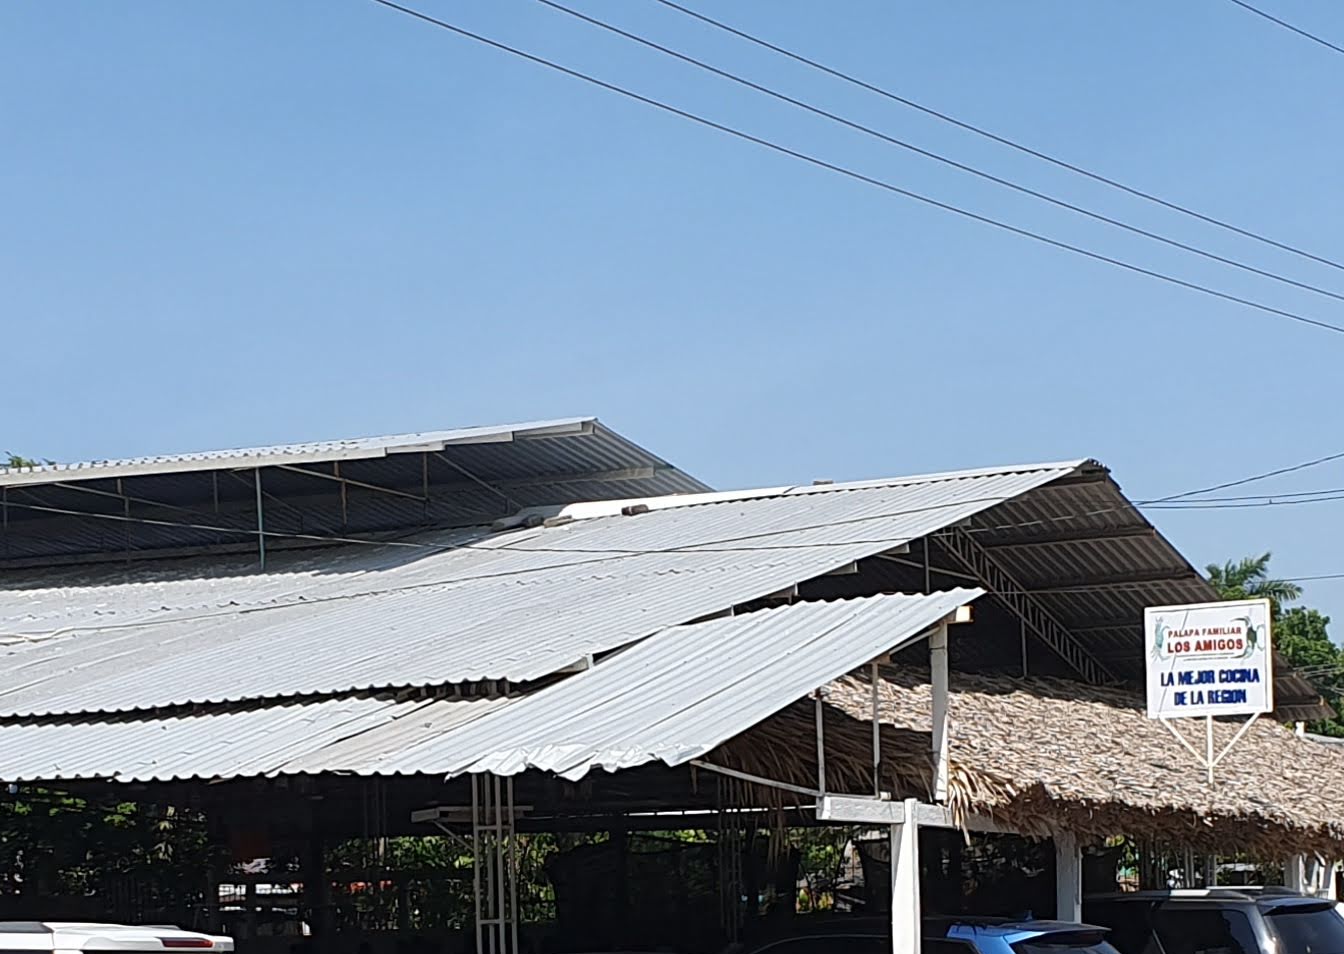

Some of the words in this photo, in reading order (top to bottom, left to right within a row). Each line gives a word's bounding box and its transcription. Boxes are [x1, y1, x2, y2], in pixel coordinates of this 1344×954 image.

[1168, 629, 1200, 638] PALAPA
[1202, 627, 1242, 636] FAMILIAR
[1167, 641, 1191, 654] LOS
[1194, 638, 1244, 652] AMIGOS
[1161, 672, 1175, 687] LA
[1178, 670, 1216, 686] MEJOR
[1219, 668, 1260, 683] COCINA
[1174, 691, 1188, 706] DE
[1190, 690, 1205, 705] LA
[1207, 689, 1247, 704] REGION
